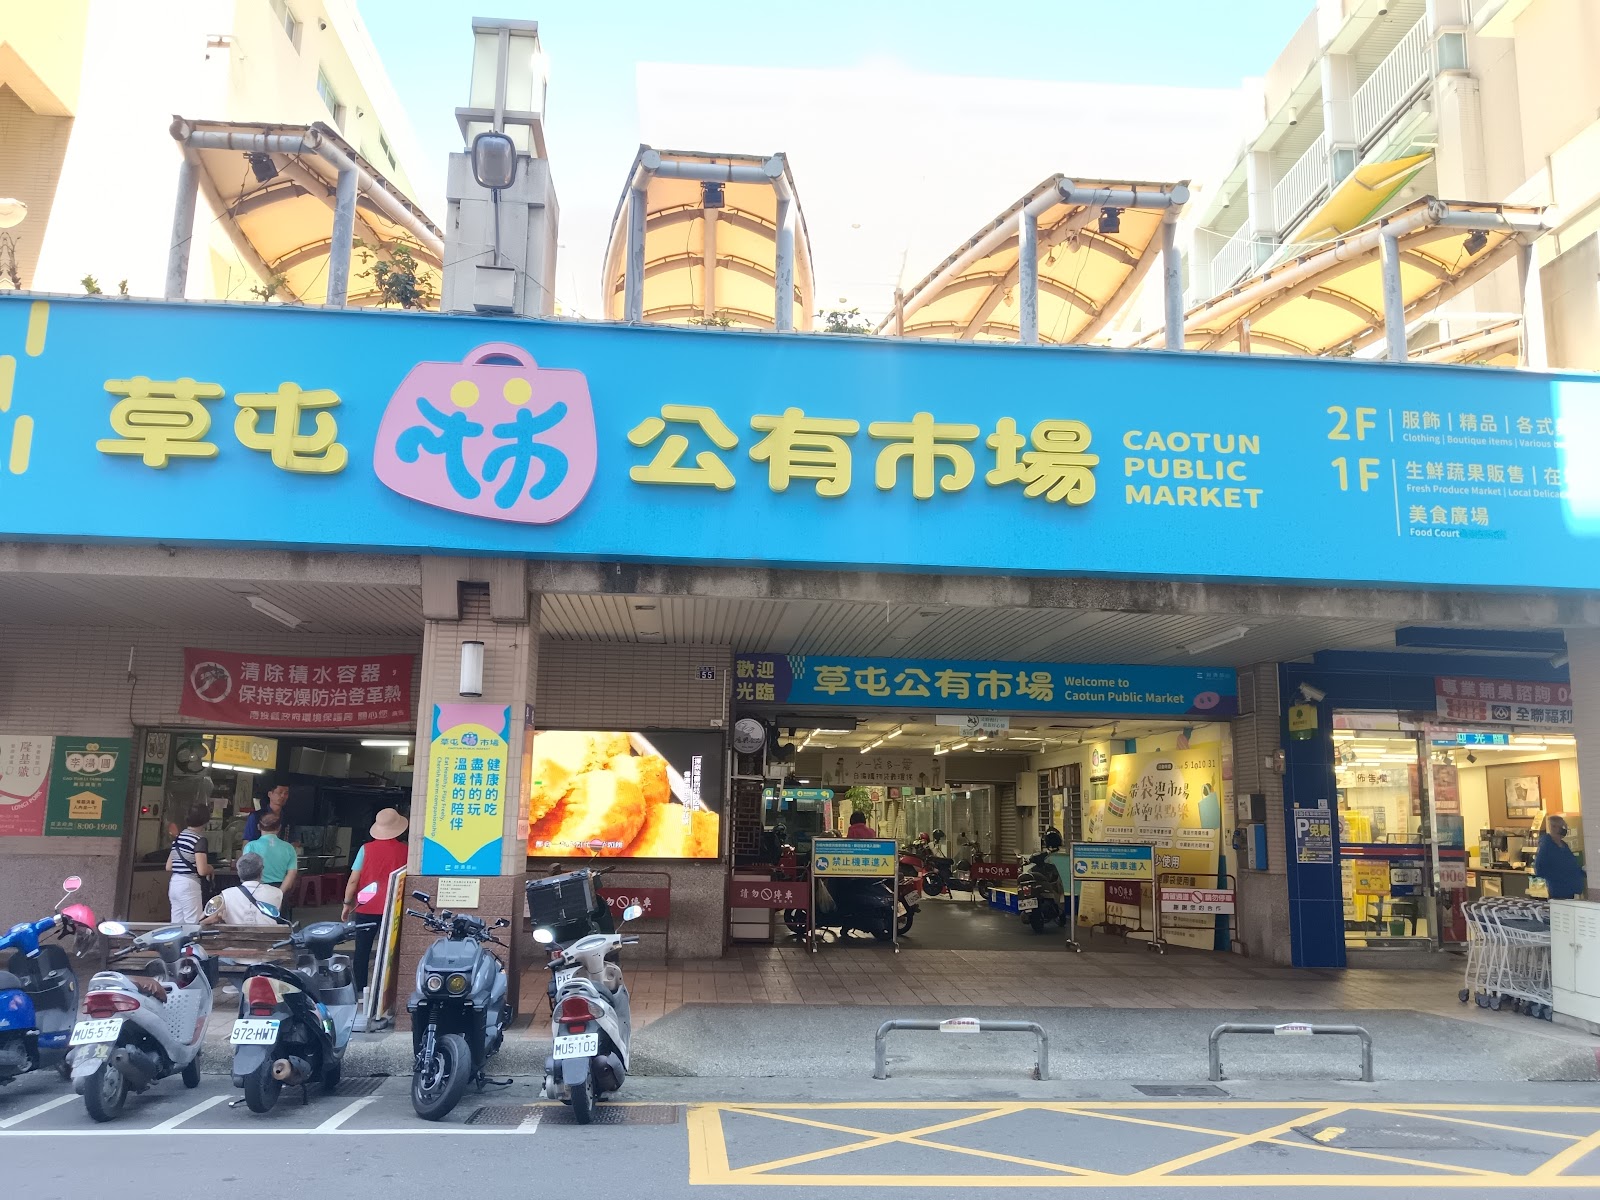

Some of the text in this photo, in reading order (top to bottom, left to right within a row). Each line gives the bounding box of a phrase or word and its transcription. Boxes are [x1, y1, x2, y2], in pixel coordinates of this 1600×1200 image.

[1327, 405, 1377, 441] 2F
[1402, 411, 1441, 430] 服飾
[1459, 413, 1497, 432] 精品
[96, 375, 1099, 506] 草屯 公有市場
[1122, 430, 1260, 455] CAOTUN
[1402, 433, 1441, 445] Clothing
[1447, 435, 1487, 446] Boutique
[1488, 437, 1513, 447] items
[1519, 439, 1552, 448] Various
[1124, 457, 1247, 481] PUBLIC
[1331, 456, 1381, 491] 1F
[1406, 461, 1524, 484] 生鮮蔬果販售
[1125, 484, 1264, 508] MARKET
[1406, 483, 1431, 493] Fresh
[1433, 485, 1470, 495] Produce
[1471, 487, 1501, 496] Market
[1508, 488, 1531, 497] Local
[1409, 504, 1489, 526] 美食廣場
[1409, 527, 1460, 538] Food Court
[737, 660, 774, 679] 歡迎
[737, 682, 774, 701] 光臨
[813, 665, 1055, 702] 草屯公有市場
[1064, 676, 1130, 688] Welcome to
[238, 684, 402, 708] 保持乾燥防治登革熱
[1065, 690, 1184, 704] Caotun Public Market
[450, 757, 467, 830] 溫暖的陪伴
[467, 757, 483, 816] 盡情的玩
[484, 758, 500, 816] 健康的吃
[1297, 818, 1310, 838] P
[832, 857, 889, 867] 禁止機車進入
[1091, 861, 1146, 871] 禁止機車進入
[232, 1027, 277, 1040] 972-HWT
[555, 1041, 597, 1056] MU5-103
